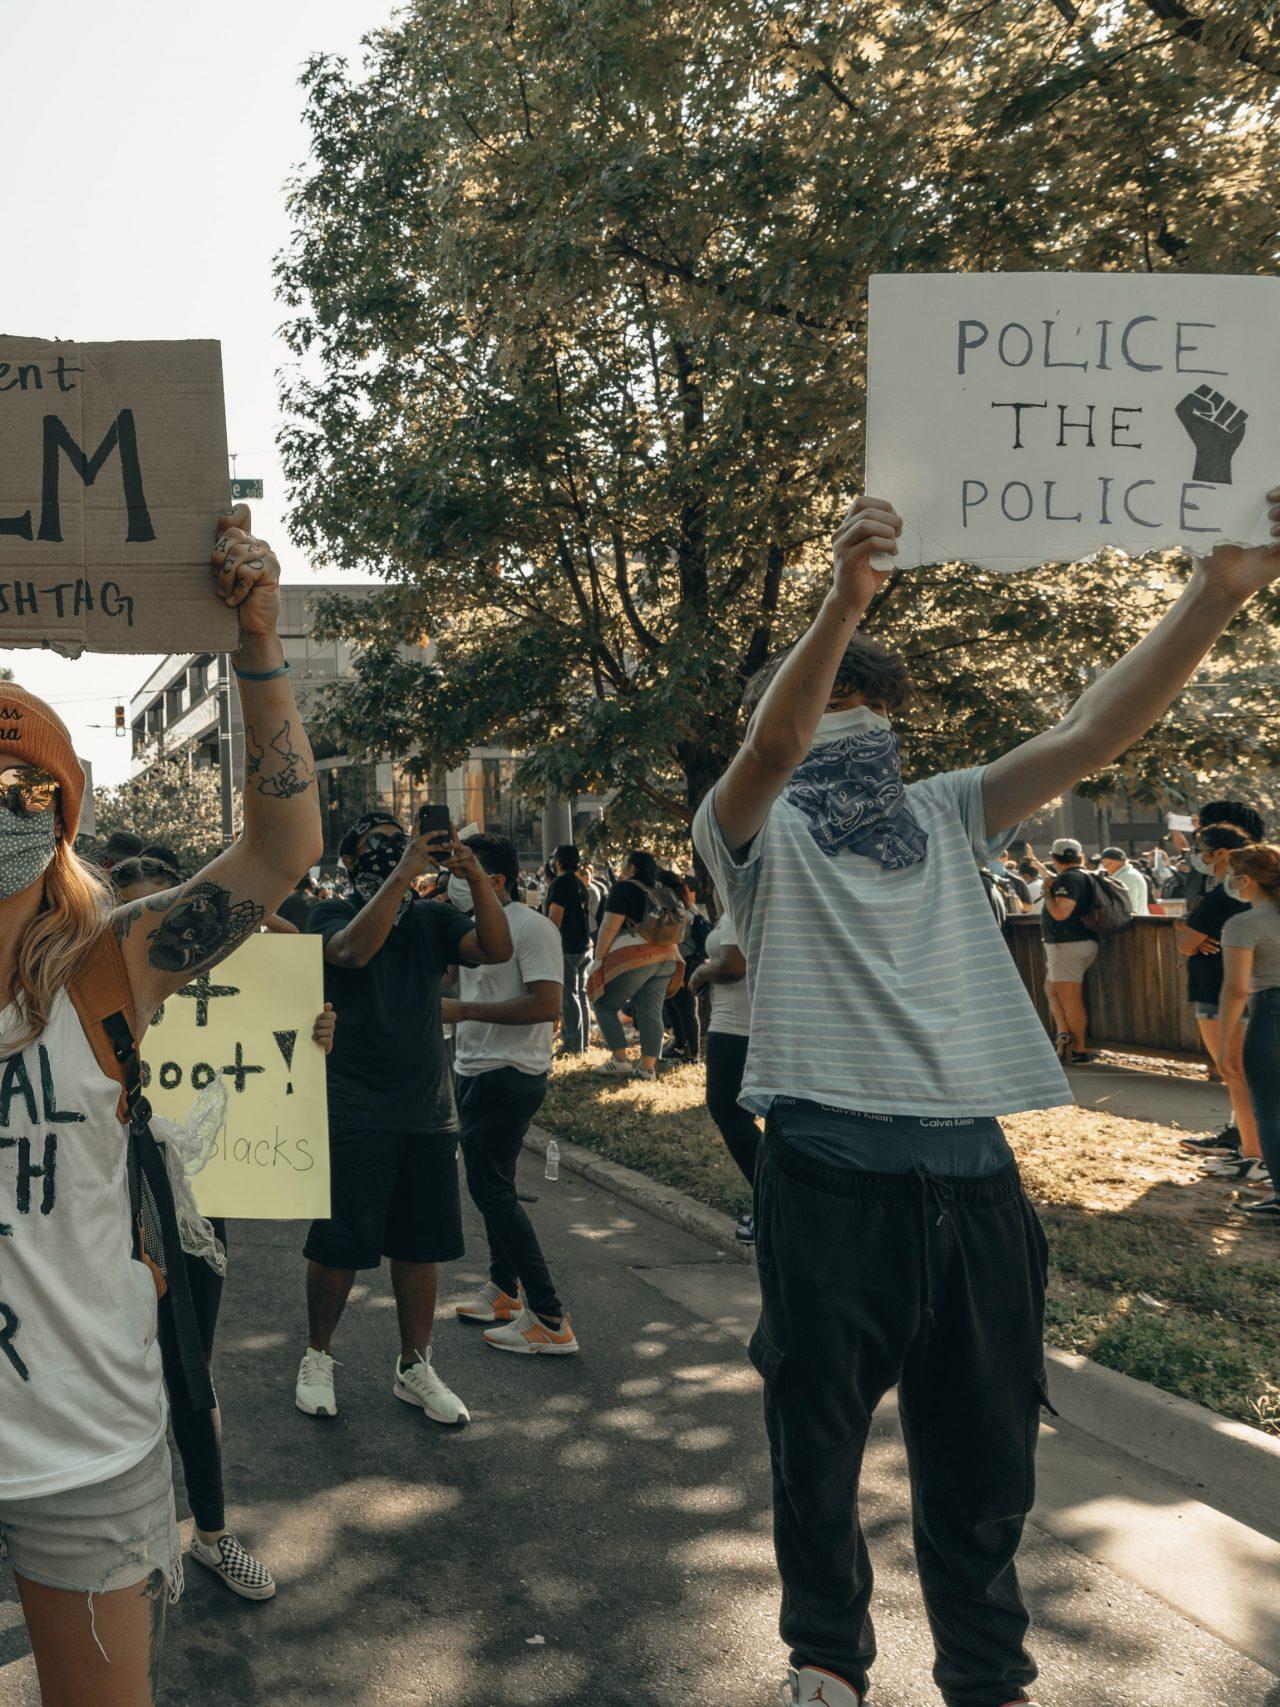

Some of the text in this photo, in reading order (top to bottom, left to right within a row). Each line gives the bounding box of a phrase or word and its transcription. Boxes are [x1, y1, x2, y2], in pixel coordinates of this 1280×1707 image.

[958, 314, 1229, 376] POLICE
[991, 399, 1143, 450] THE
[962, 477, 1222, 532] POLICE
[919, 1116, 975, 1127] Calvin Klein
